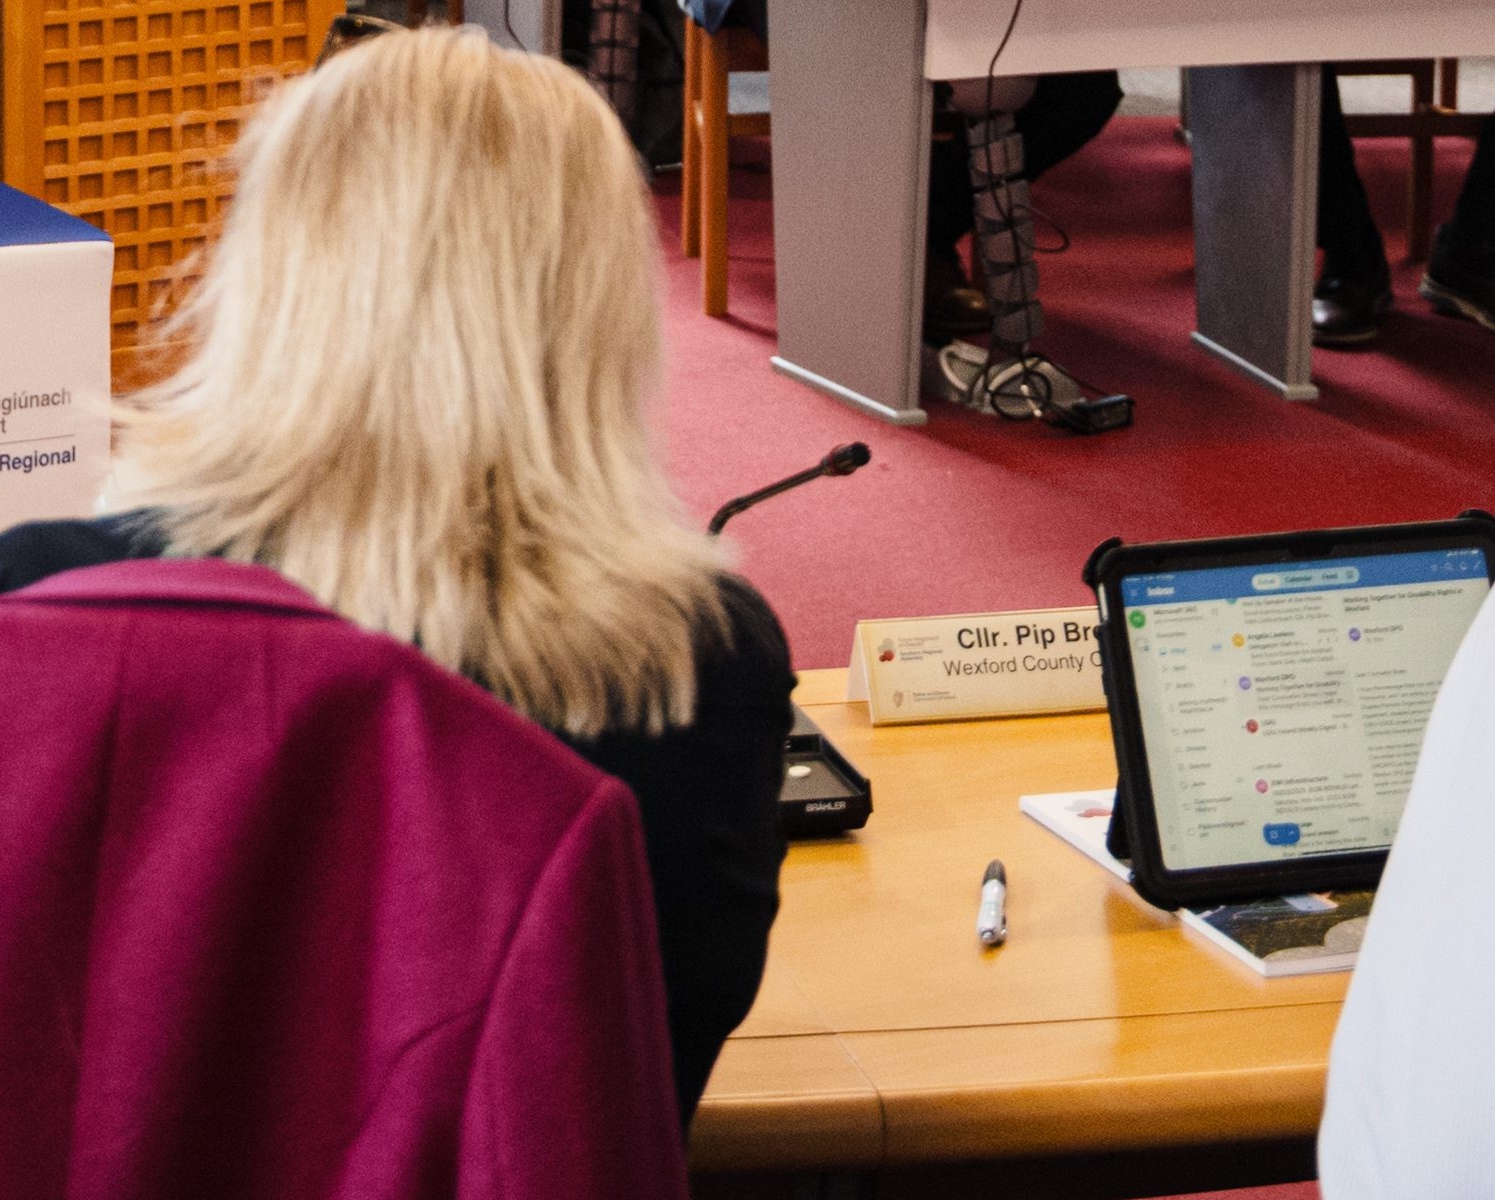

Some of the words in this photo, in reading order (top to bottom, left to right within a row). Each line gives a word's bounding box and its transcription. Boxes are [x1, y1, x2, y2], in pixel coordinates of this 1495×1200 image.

[0, 446, 77, 473] Regional
[957, 628, 1008, 649] Cllr.
[1016, 623, 1055, 649] Pip
[943, 657, 1017, 677] Wexford
[1022, 653, 1085, 673] County
